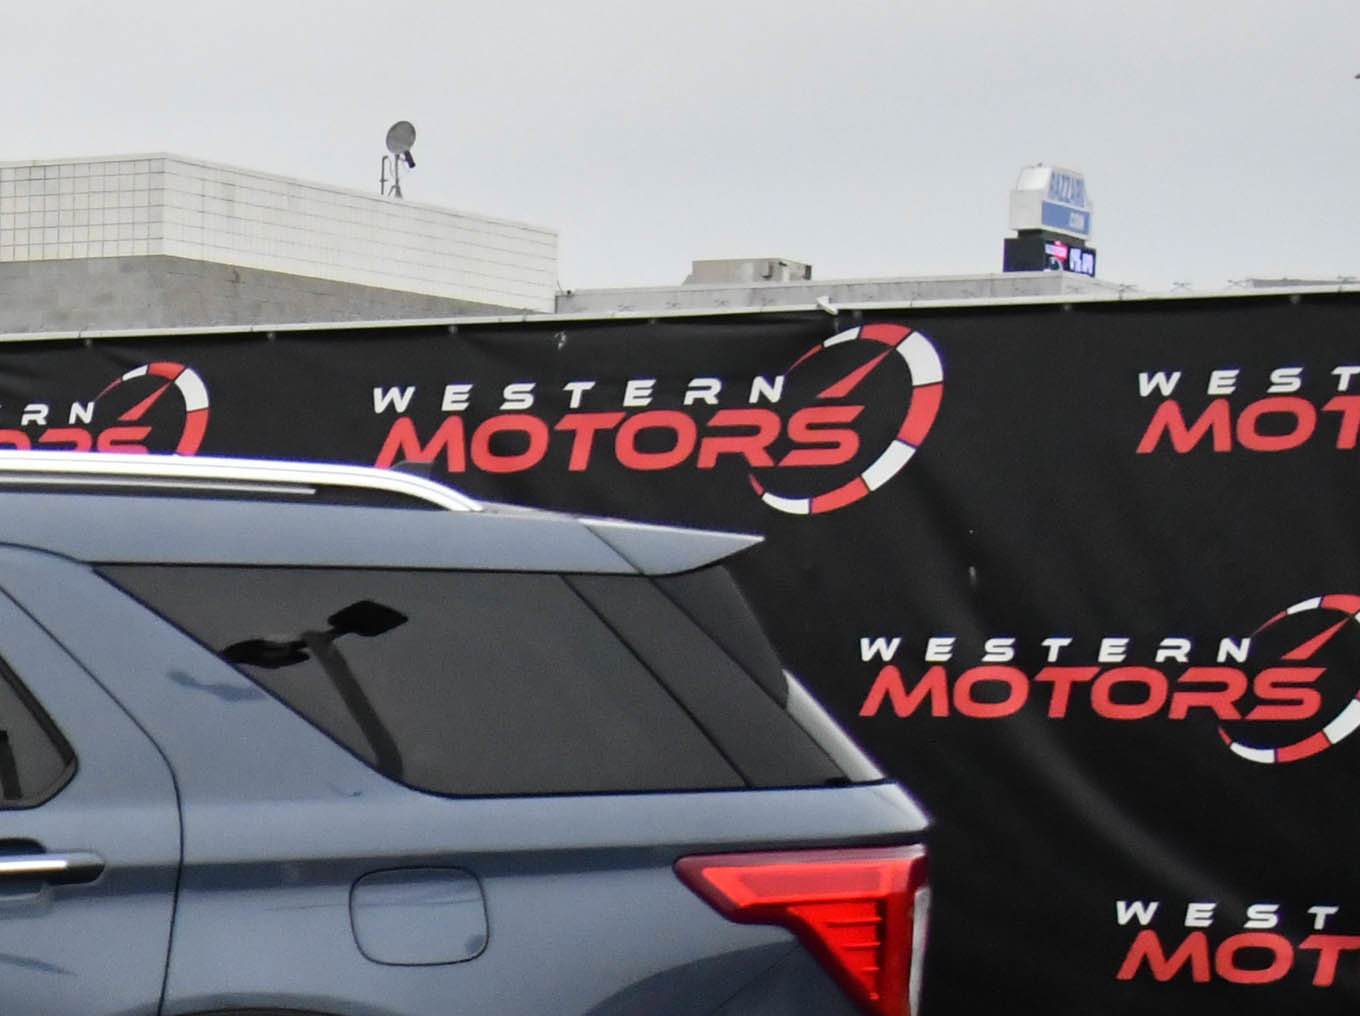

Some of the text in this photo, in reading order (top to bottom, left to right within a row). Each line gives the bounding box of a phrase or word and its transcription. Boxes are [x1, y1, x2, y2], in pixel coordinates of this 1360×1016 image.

[373, 375, 785, 414] WESTERN
[1139, 366, 1360, 397] WEST
[373, 404, 865, 474] MOTORS
[860, 637, 1251, 663] WESTERN
[859, 664, 1326, 721] MOTORS
[1116, 900, 1338, 930] WEST
